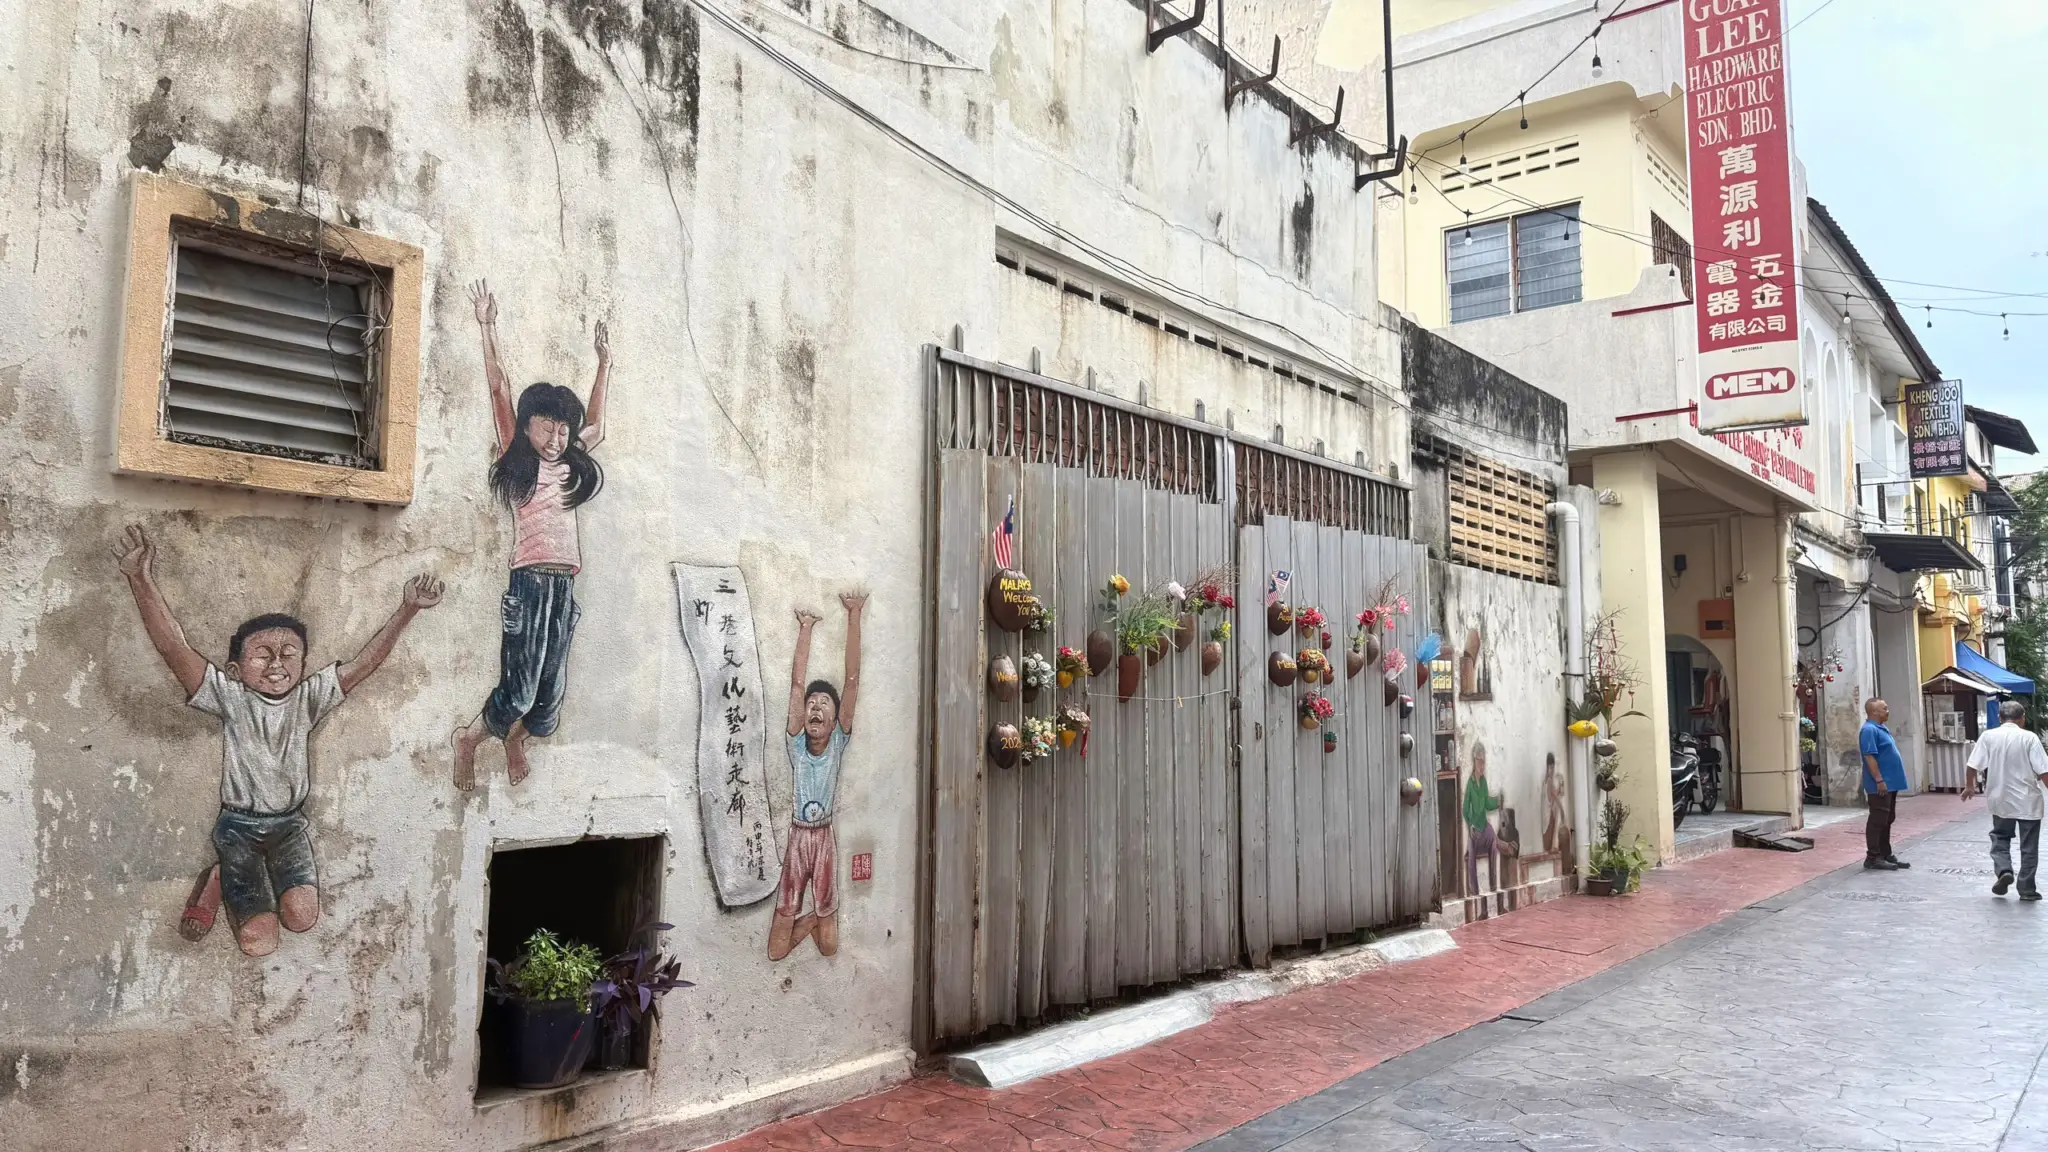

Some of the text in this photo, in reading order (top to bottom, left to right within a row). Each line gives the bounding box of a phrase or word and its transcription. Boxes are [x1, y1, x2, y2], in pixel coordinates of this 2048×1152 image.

[1689, 0, 1761, 22] GU
[1695, 9, 1771, 59] LEE
[1688, 43, 1781, 92] HARDWARE
[1696, 75, 1775, 119] ELECTRIC
[1698, 106, 1777, 148] SDN. BHD.
[1717, 143, 1761, 250] 萬源利
[1706, 259, 1740, 317] 電器
[1749, 253, 1785, 310] 五金
[1709, 314, 1787, 342] 有限公司
[1713, 370, 1788, 398] MEM
[1910, 386, 1958, 404] KHENG JOO
[1914, 422, 1958, 438] SDN. BHD.
[1921, 406, 1949, 420] TEXTILE
